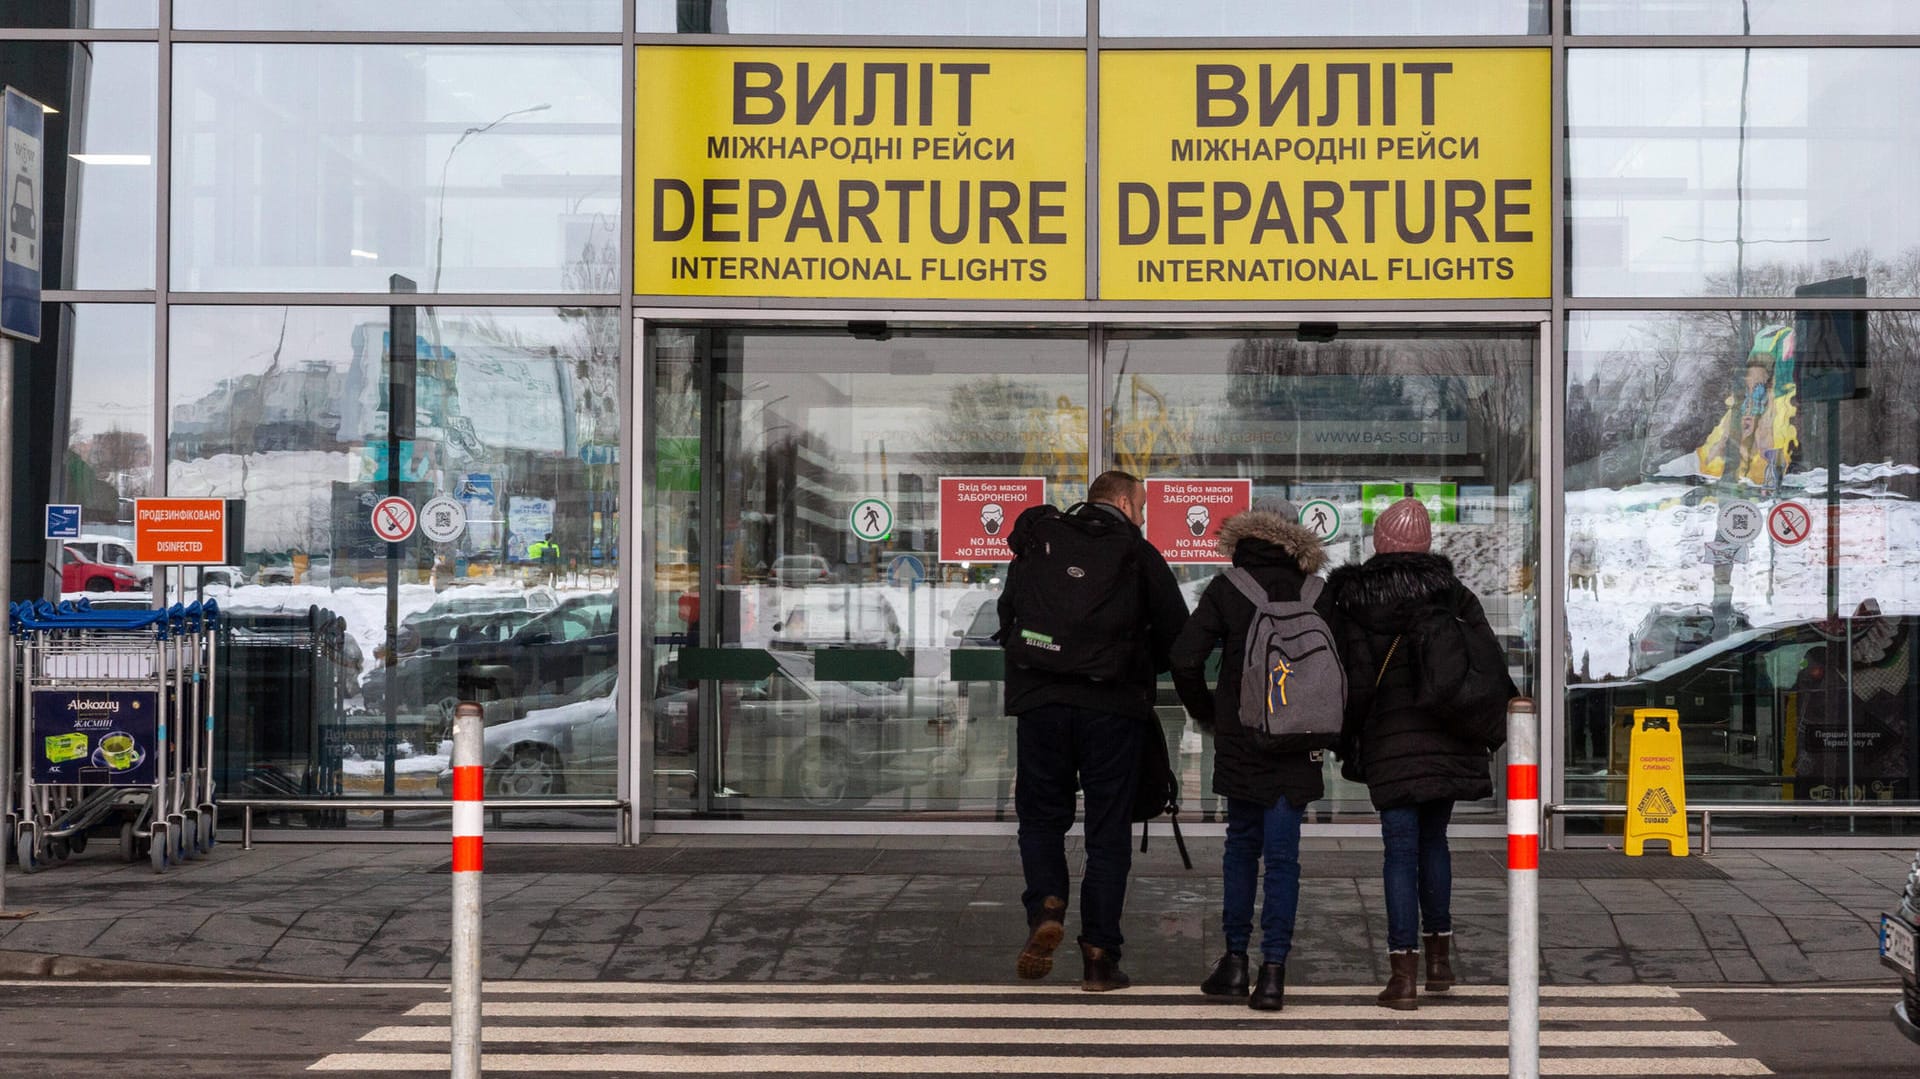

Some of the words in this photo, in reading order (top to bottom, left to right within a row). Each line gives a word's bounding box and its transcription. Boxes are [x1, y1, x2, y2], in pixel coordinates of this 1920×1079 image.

[733, 62, 990, 126] ВИЛІТ
[1196, 63, 1452, 128] ВИЛІТ
[707, 136, 901, 164] МІЖНАРОДНІ
[913, 132, 1015, 161] РЕЙСИ
[1171, 137, 1366, 165] МІЖНАРОДНІ
[1377, 131, 1479, 160] РЕЙСИ
[653, 179, 1067, 245] DEPARTURE
[1118, 179, 1534, 246] DEPARTURE
[671, 257, 912, 281] INTERNATIONAL
[921, 259, 1047, 282] FLIGHTS
[1138, 258, 1378, 283] INTERNATIONAL
[1388, 257, 1514, 281] FLIGHTS
[1315, 432, 1460, 443] WWW.BAS-SOFT.EU
[958, 483, 979, 492] Вхід
[981, 483, 997, 491] без
[1164, 485, 1184, 493] Вхід
[1187, 485, 1203, 493] без
[958, 493, 1028, 502] ЗАБОРОНЕНО!
[1163, 495, 1233, 503] ЗАБОРОНЕНО!
[139, 510, 221, 521] ПРОДЕЗИНФІКОВАНО
[157, 541, 203, 552] DISINFECTED
[970, 538, 984, 546] NO
[987, 538, 1008, 546] MAS
[1176, 539, 1190, 547] NO
[975, 548, 1014, 556] ENTRAN
[67, 699, 120, 713] Alokozay
